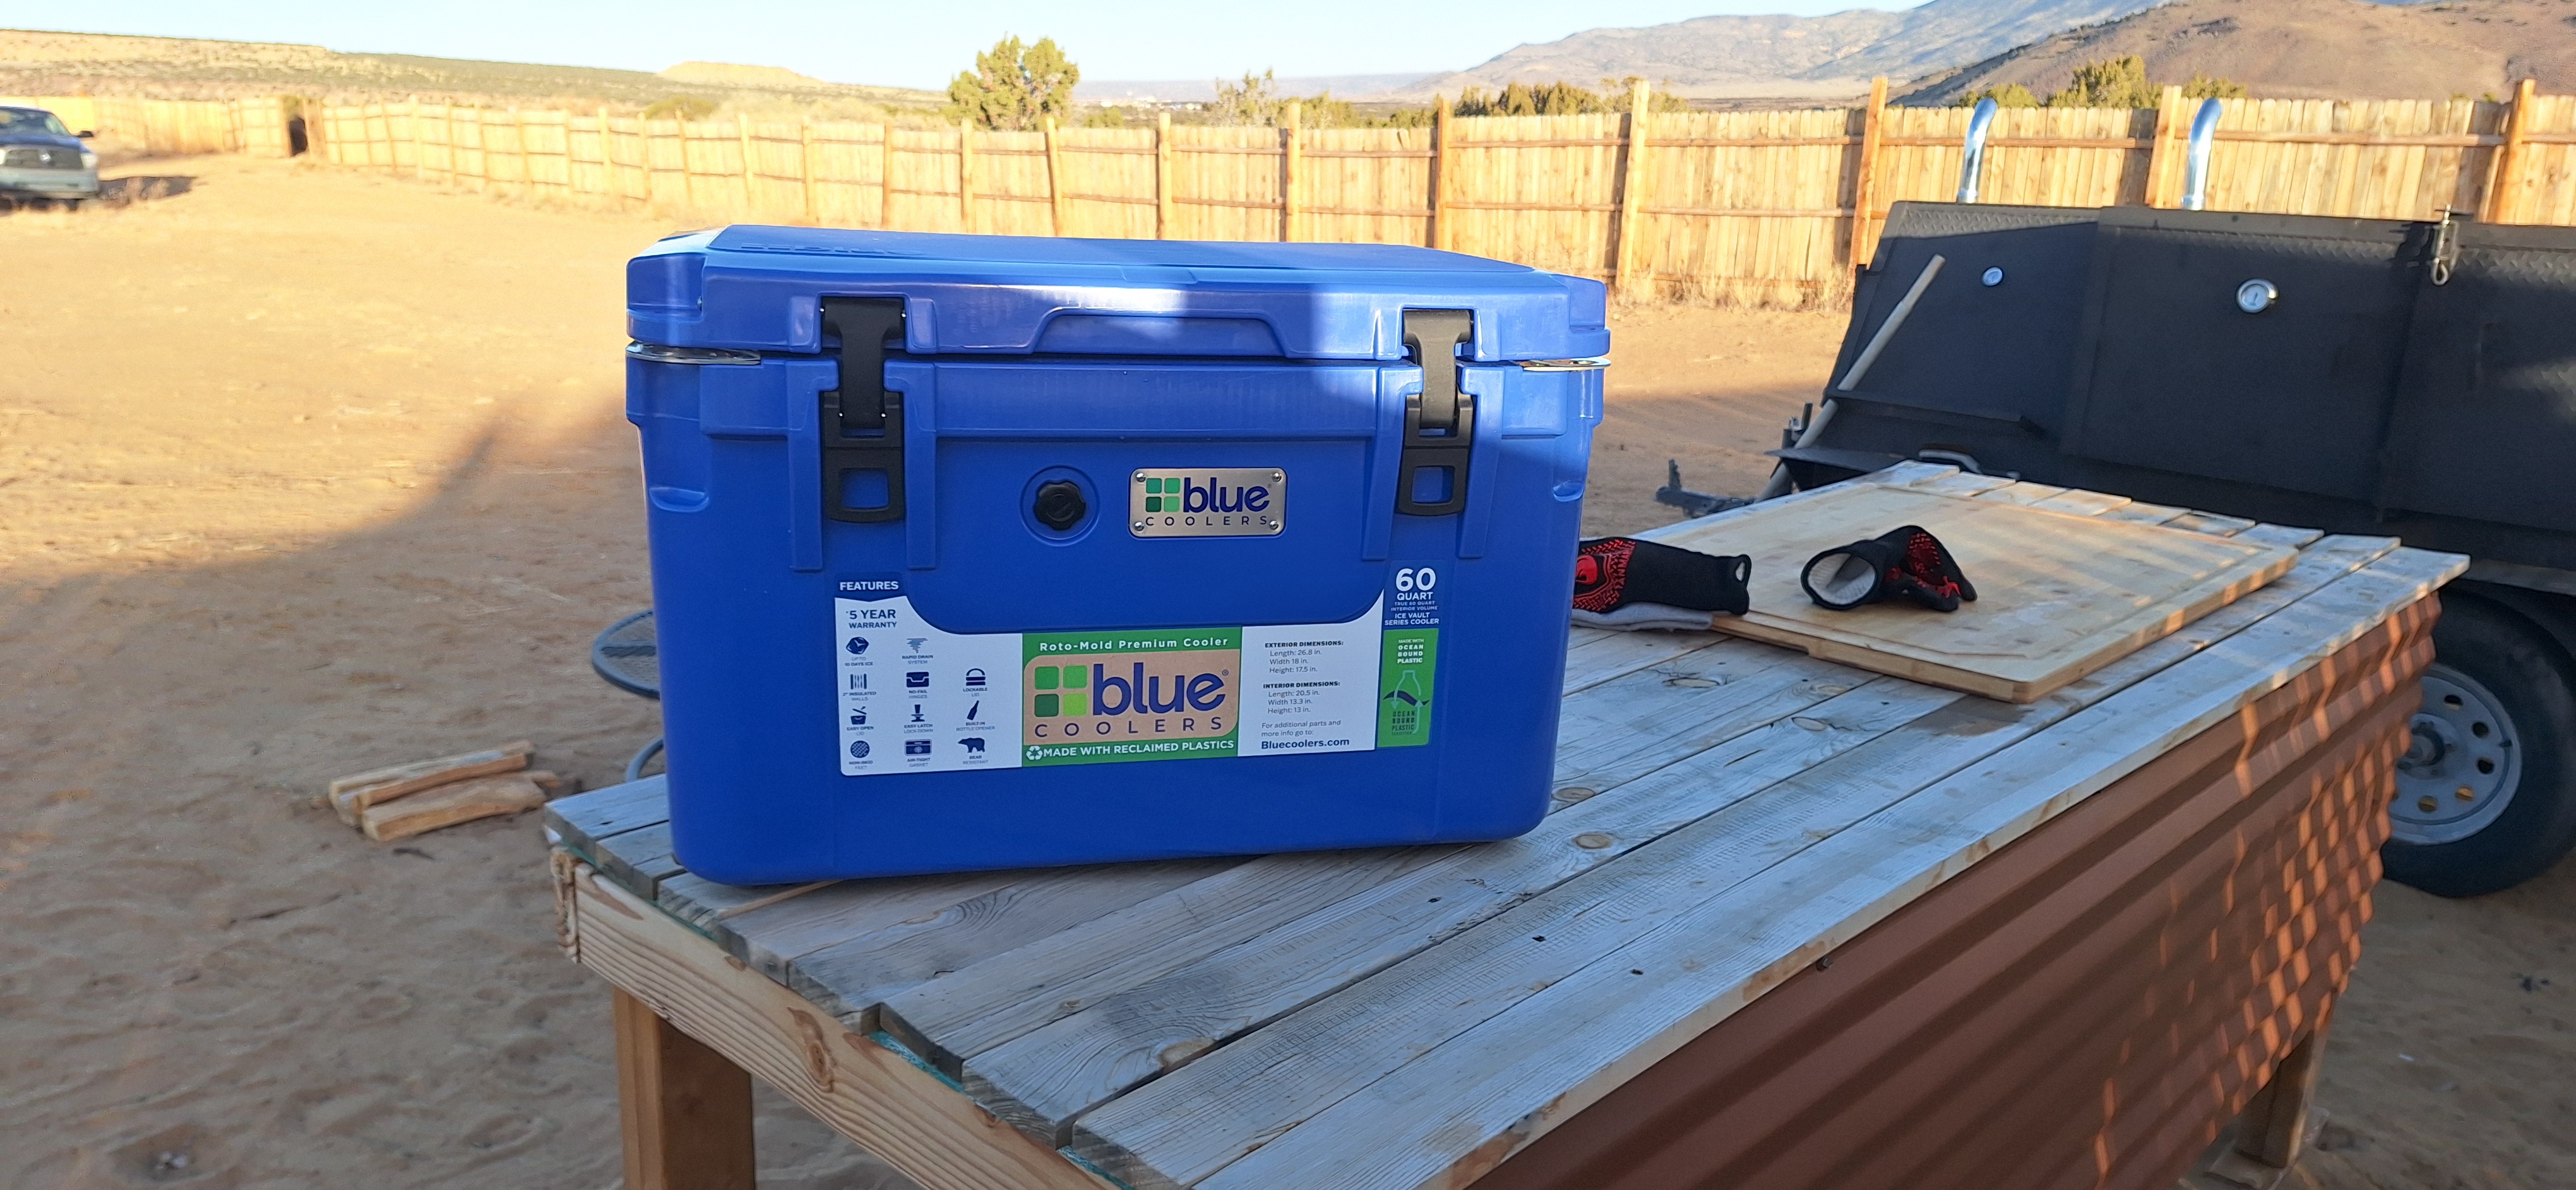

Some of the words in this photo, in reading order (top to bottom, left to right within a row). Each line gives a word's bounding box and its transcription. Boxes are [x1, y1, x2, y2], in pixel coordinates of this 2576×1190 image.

[1145, 515, 1267, 526] COOLERS
[1395, 567, 1436, 592] 60
[839, 580, 899, 591] FEATURES
[1397, 592, 1433, 601] QUART
[860, 609, 897, 620] YEAR
[848, 621, 897, 629] WARRANTY
[1040, 640, 1112, 652] Roto-Mold
[1118, 638, 1178, 650] Premium
[1183, 637, 1229, 647] Cooler
[1270, 649, 1296, 658] Length:
[1267, 707, 1292, 715] Height:
[1034, 716, 1222, 738] COOLERS
[1043, 747, 1077, 758] MADE
[1080, 745, 1111, 756] WITH
[1113, 742, 1179, 755] RECLAIMED
[1181, 739, 1235, 752] PLASTICS
[1261, 738, 1350, 750] Bluecoolers.com
